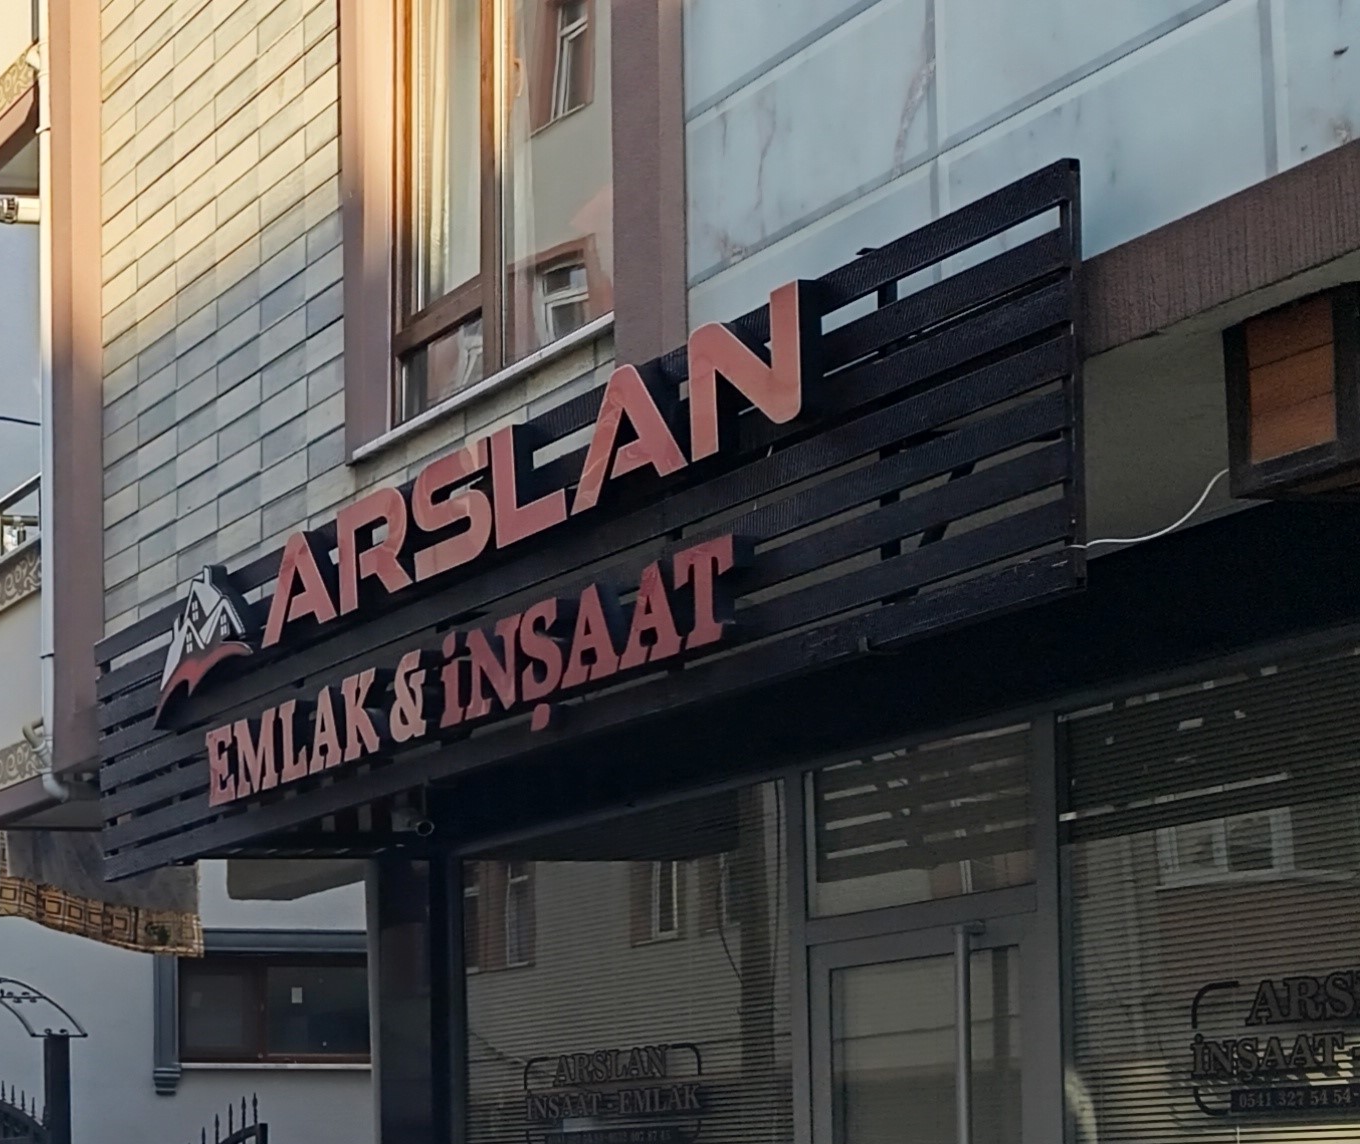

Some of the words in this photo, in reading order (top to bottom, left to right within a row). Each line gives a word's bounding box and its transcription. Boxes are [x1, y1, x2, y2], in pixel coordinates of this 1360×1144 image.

[261, 279, 802, 649] ARSLAN
[204, 667, 381, 808] EMLAK
[388, 649, 428, 746] &
[1244, 970, 1360, 1026] ARS
[553, 1044, 672, 1087] ARSLAN
[1310, 1089, 1329, 1105] 54
